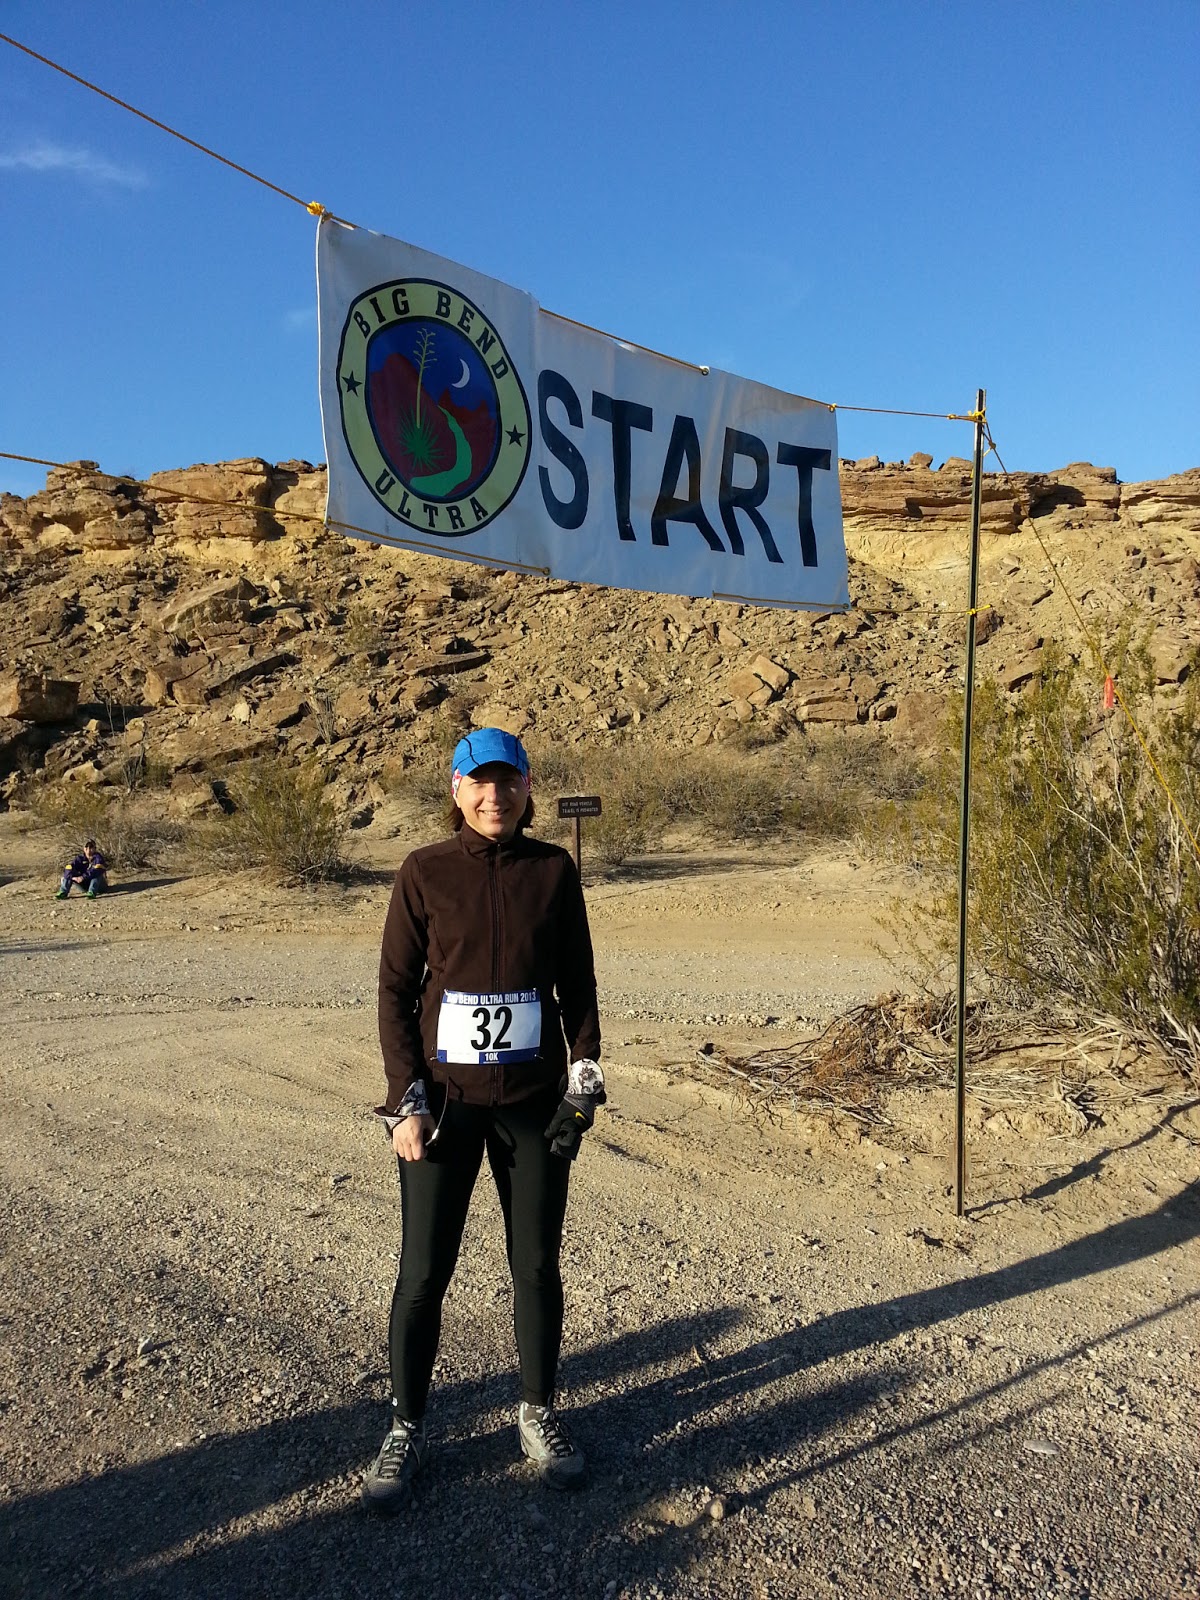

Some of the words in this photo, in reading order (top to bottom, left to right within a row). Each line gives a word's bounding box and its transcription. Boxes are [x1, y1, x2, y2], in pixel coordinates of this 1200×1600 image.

[353, 288, 410, 337] BIG
[435, 289, 508, 380] BEND
[538, 369, 832, 567] START
[375, 469, 490, 530] ULTRA
[459, 994, 478, 1005] BEND
[480, 994, 503, 1005] ULTRA
[504, 993, 519, 1004] RUN
[520, 991, 537, 1002] 2013
[470, 1006, 513, 1051] 32
[484, 1052, 499, 1061] 10K
